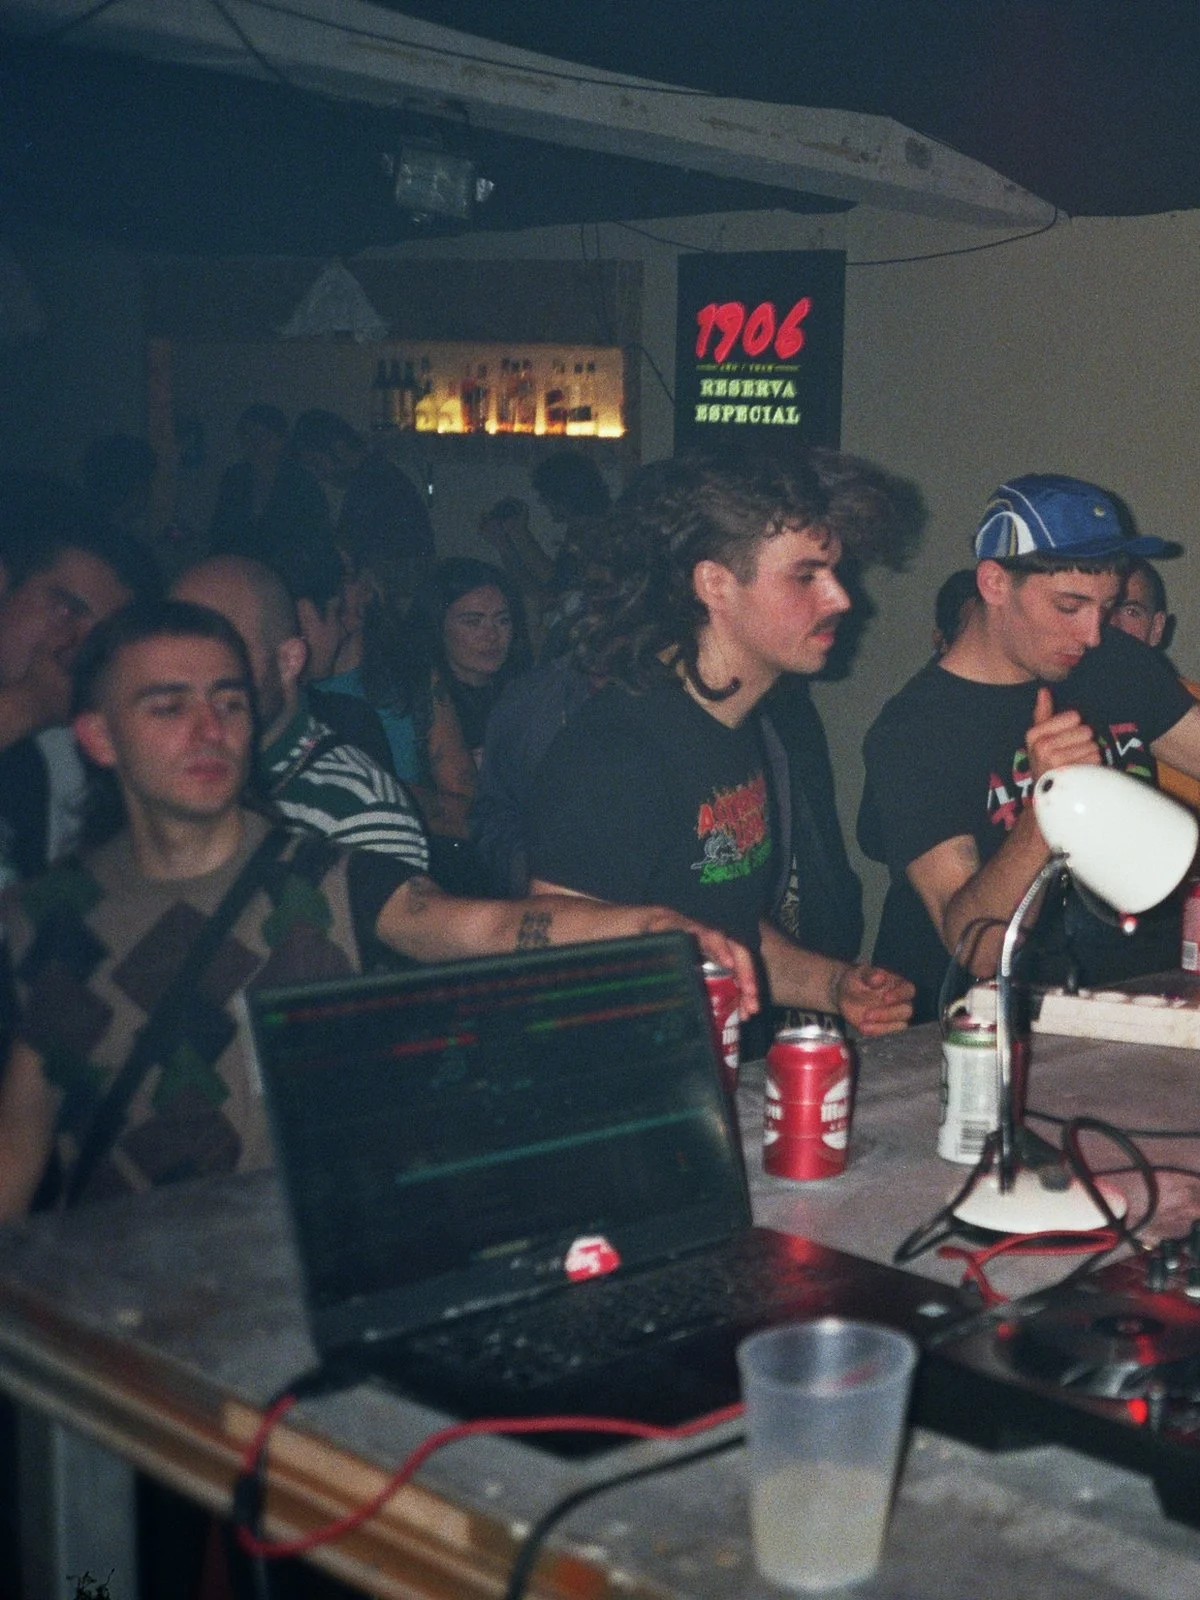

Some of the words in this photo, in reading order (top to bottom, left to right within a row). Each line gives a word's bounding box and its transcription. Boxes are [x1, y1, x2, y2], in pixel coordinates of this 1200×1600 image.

[696, 297, 811, 363] 1906
[700, 379, 796, 398] RESERVA
[694, 404, 800, 425] ESPECIAL
